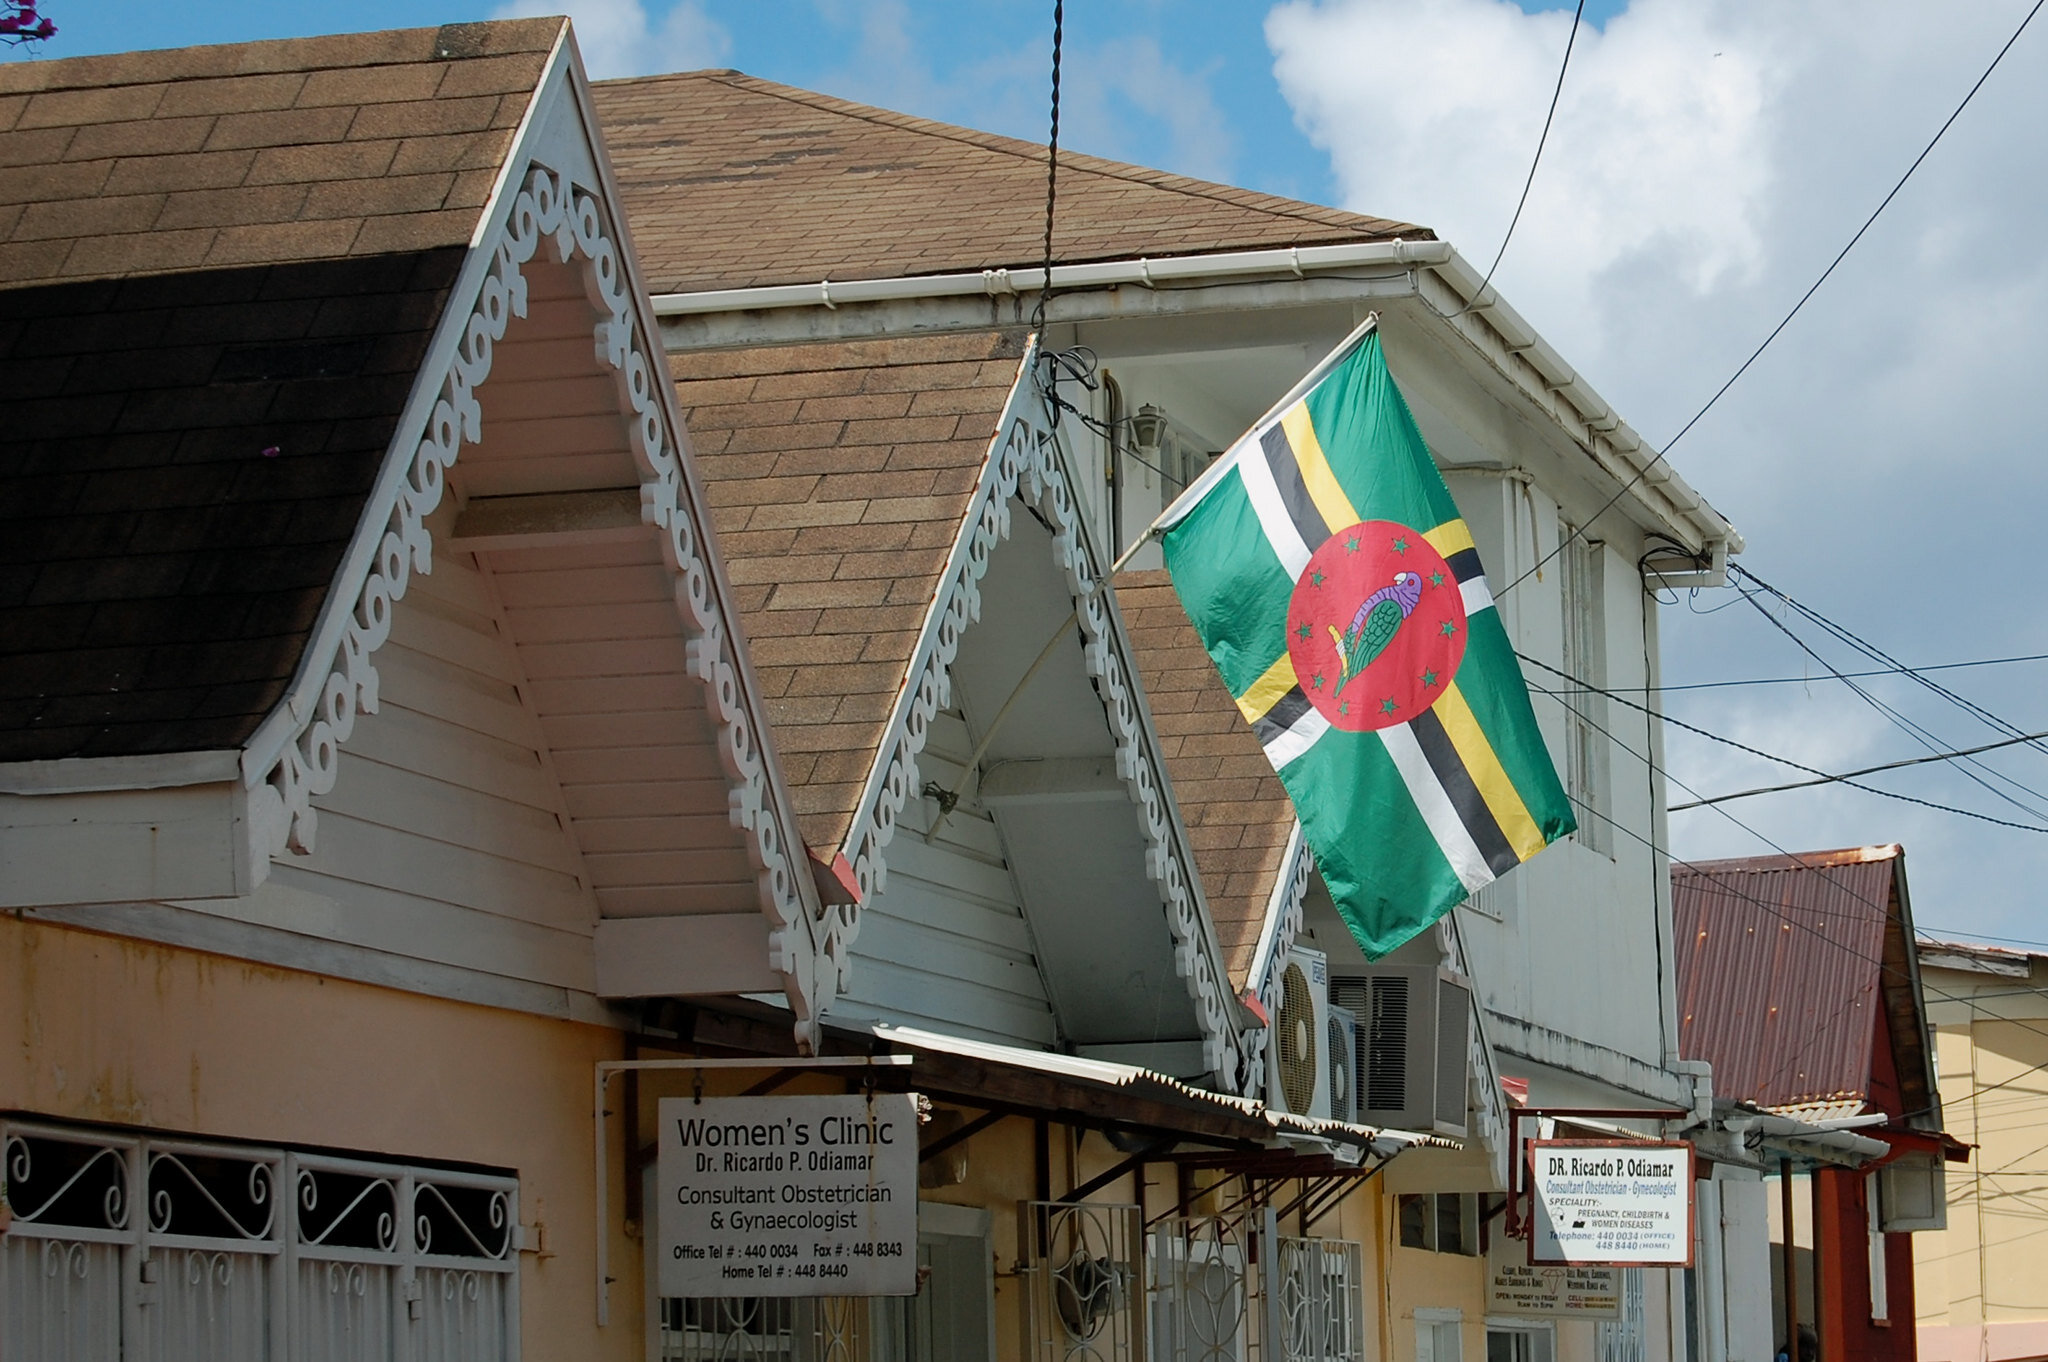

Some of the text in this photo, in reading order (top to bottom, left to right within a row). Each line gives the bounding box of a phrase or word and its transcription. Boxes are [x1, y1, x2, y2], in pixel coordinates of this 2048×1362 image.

[677, 1116, 893, 1147] Women's Clinic
[696, 1151, 874, 1173] Dr. Ricardo P. Odiamar
[1549, 1157, 1673, 1178] DR. Ricardo P. Odiamar
[677, 1184, 891, 1205] Consultant Obstetrician
[1546, 1179, 1584, 1195] Consultant
[1585, 1180, 1628, 1195] Obstetrician
[1632, 1180, 1676, 1199] Gynecologist
[710, 1210, 858, 1233] & Gynaecologist
[1577, 1209, 1670, 1219] PREGNANCY, CHILDBIRTH &
[1592, 1220, 1654, 1230] WOMEN DISEASES
[1549, 1231, 1595, 1242] Telephone:
[1596, 1231, 1614, 1240] 440
[1616, 1231, 1639, 1240] 0034
[673, 1244, 705, 1260] Office
[708, 1244, 723, 1259] Tel
[744, 1244, 767, 1258] 440
[770, 1244, 798, 1258] 0034
[813, 1243, 831, 1257] Fax
[853, 1242, 874, 1257] 448
[876, 1242, 902, 1257] 8343
[1595, 1241, 1613, 1250] 448
[1614, 1241, 1638, 1250] 8440
[722, 1265, 754, 1279] Home
[757, 1264, 772, 1278] Tel
[794, 1263, 816, 1278] 448
[819, 1263, 848, 1278] 8440
